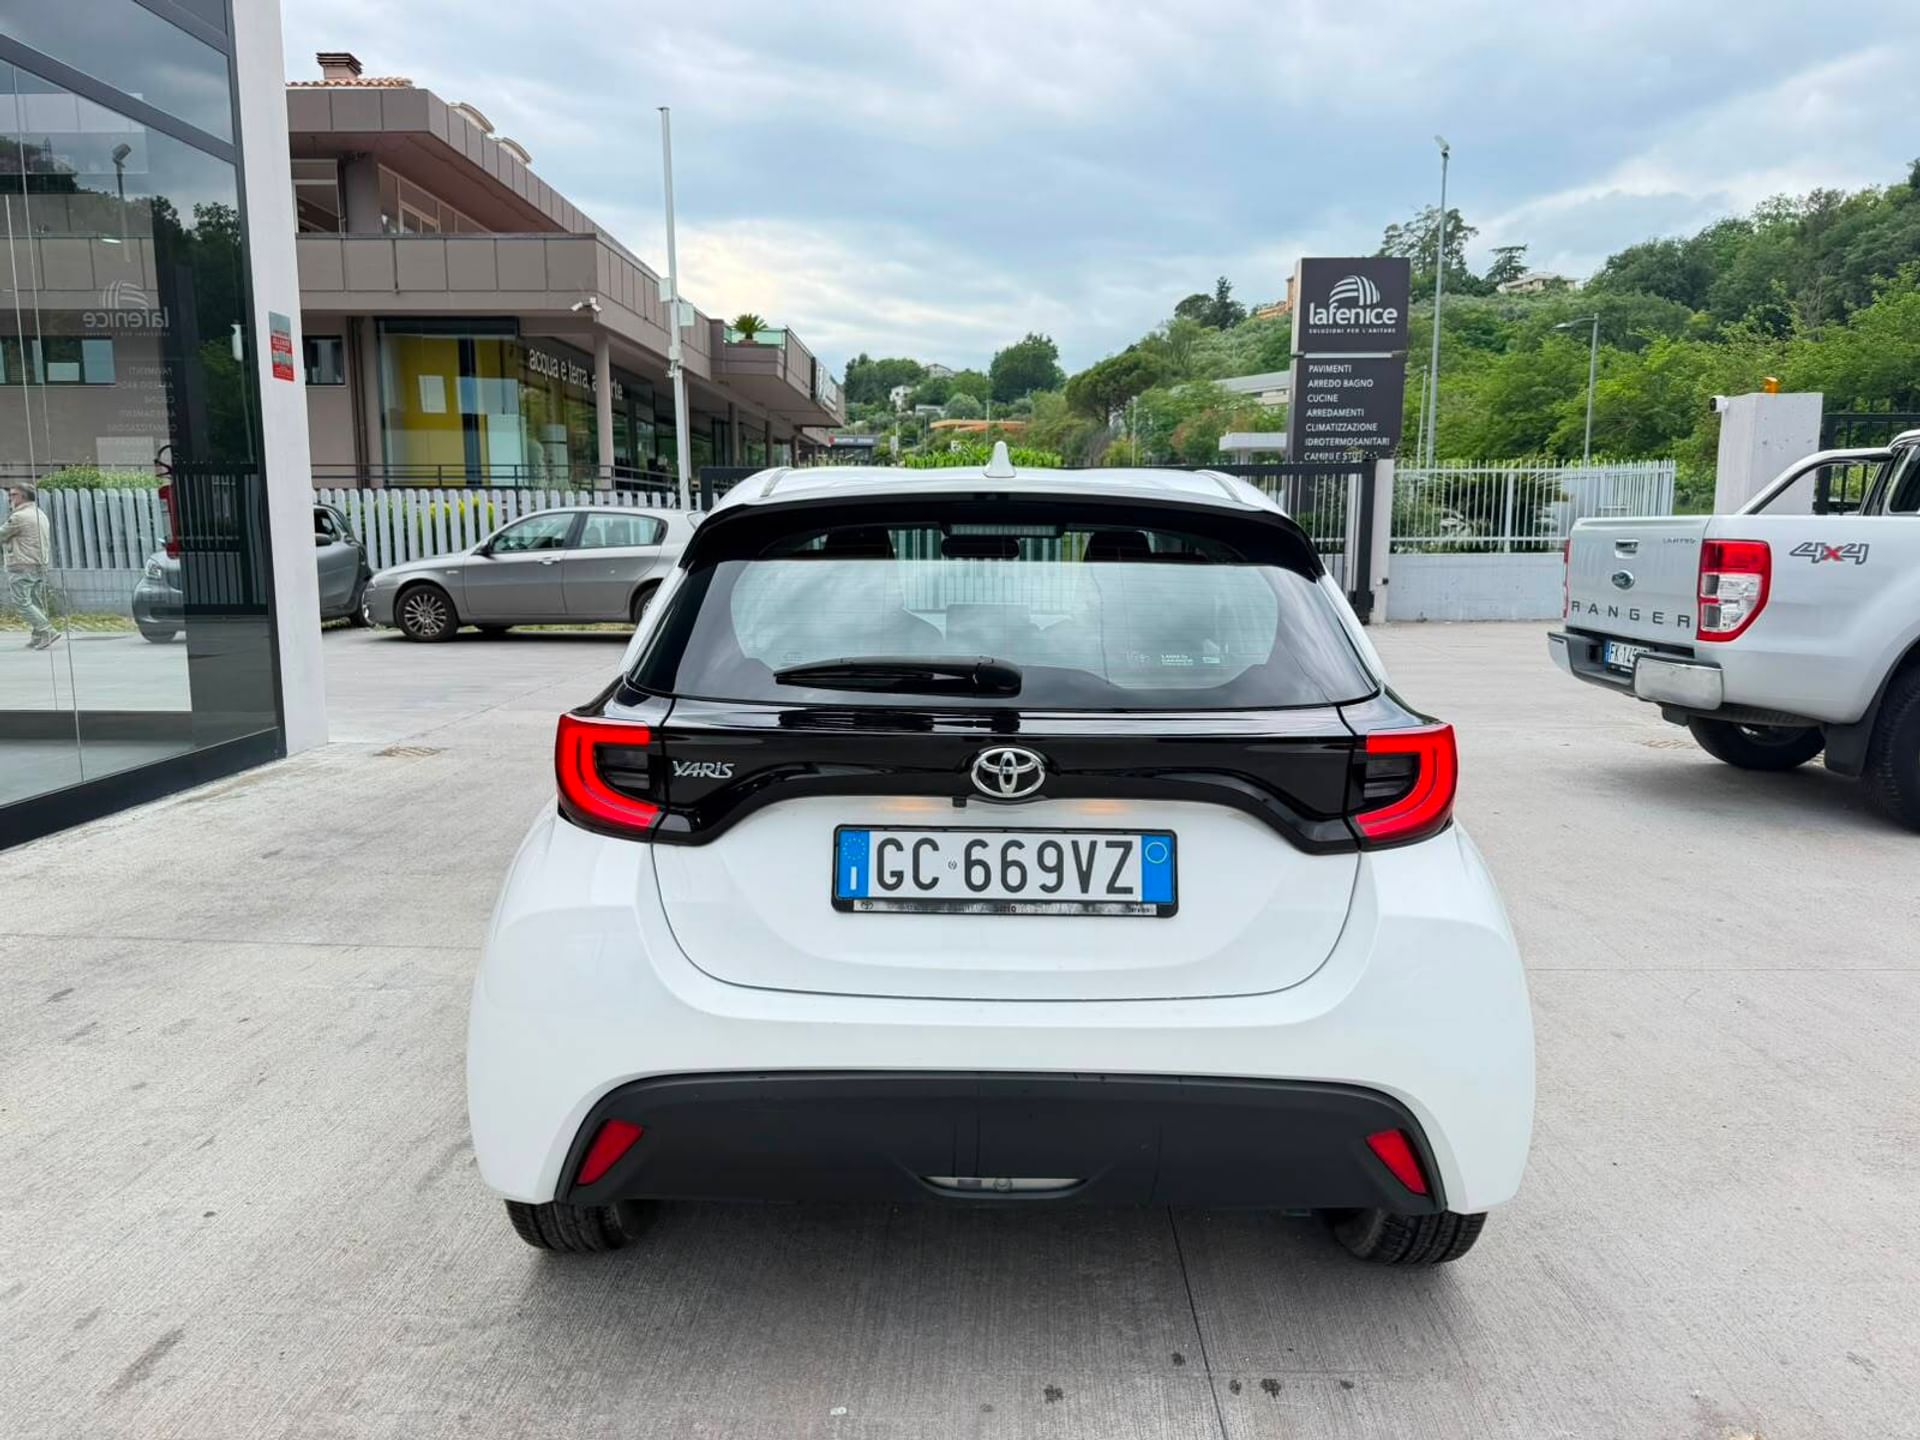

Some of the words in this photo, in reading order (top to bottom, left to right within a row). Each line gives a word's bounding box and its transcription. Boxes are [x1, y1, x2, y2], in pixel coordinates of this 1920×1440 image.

[1309, 301, 1398, 325] lafenice
[529, 348, 559, 381] acqua
[560, 360, 567, 381] e
[1308, 364, 1352, 374] PAVIMENTI
[1307, 379, 1341, 388] ARREDO
[1343, 378, 1374, 388] BAGNO
[1307, 393, 1339, 403] CUCINE
[1305, 408, 1365, 418] ARREDAMENTI
[1305, 422, 1379, 432] CLIMATIZZAZIONE
[1304, 437, 1390, 447] IDROTERMOSANITARI
[1789, 542, 1870, 565] 4x4
[1571, 600, 1691, 628] RANGER
[672, 760, 735, 779] YARIS
[876, 837, 940, 891] GC
[963, 839, 1134, 895] 669VZ
